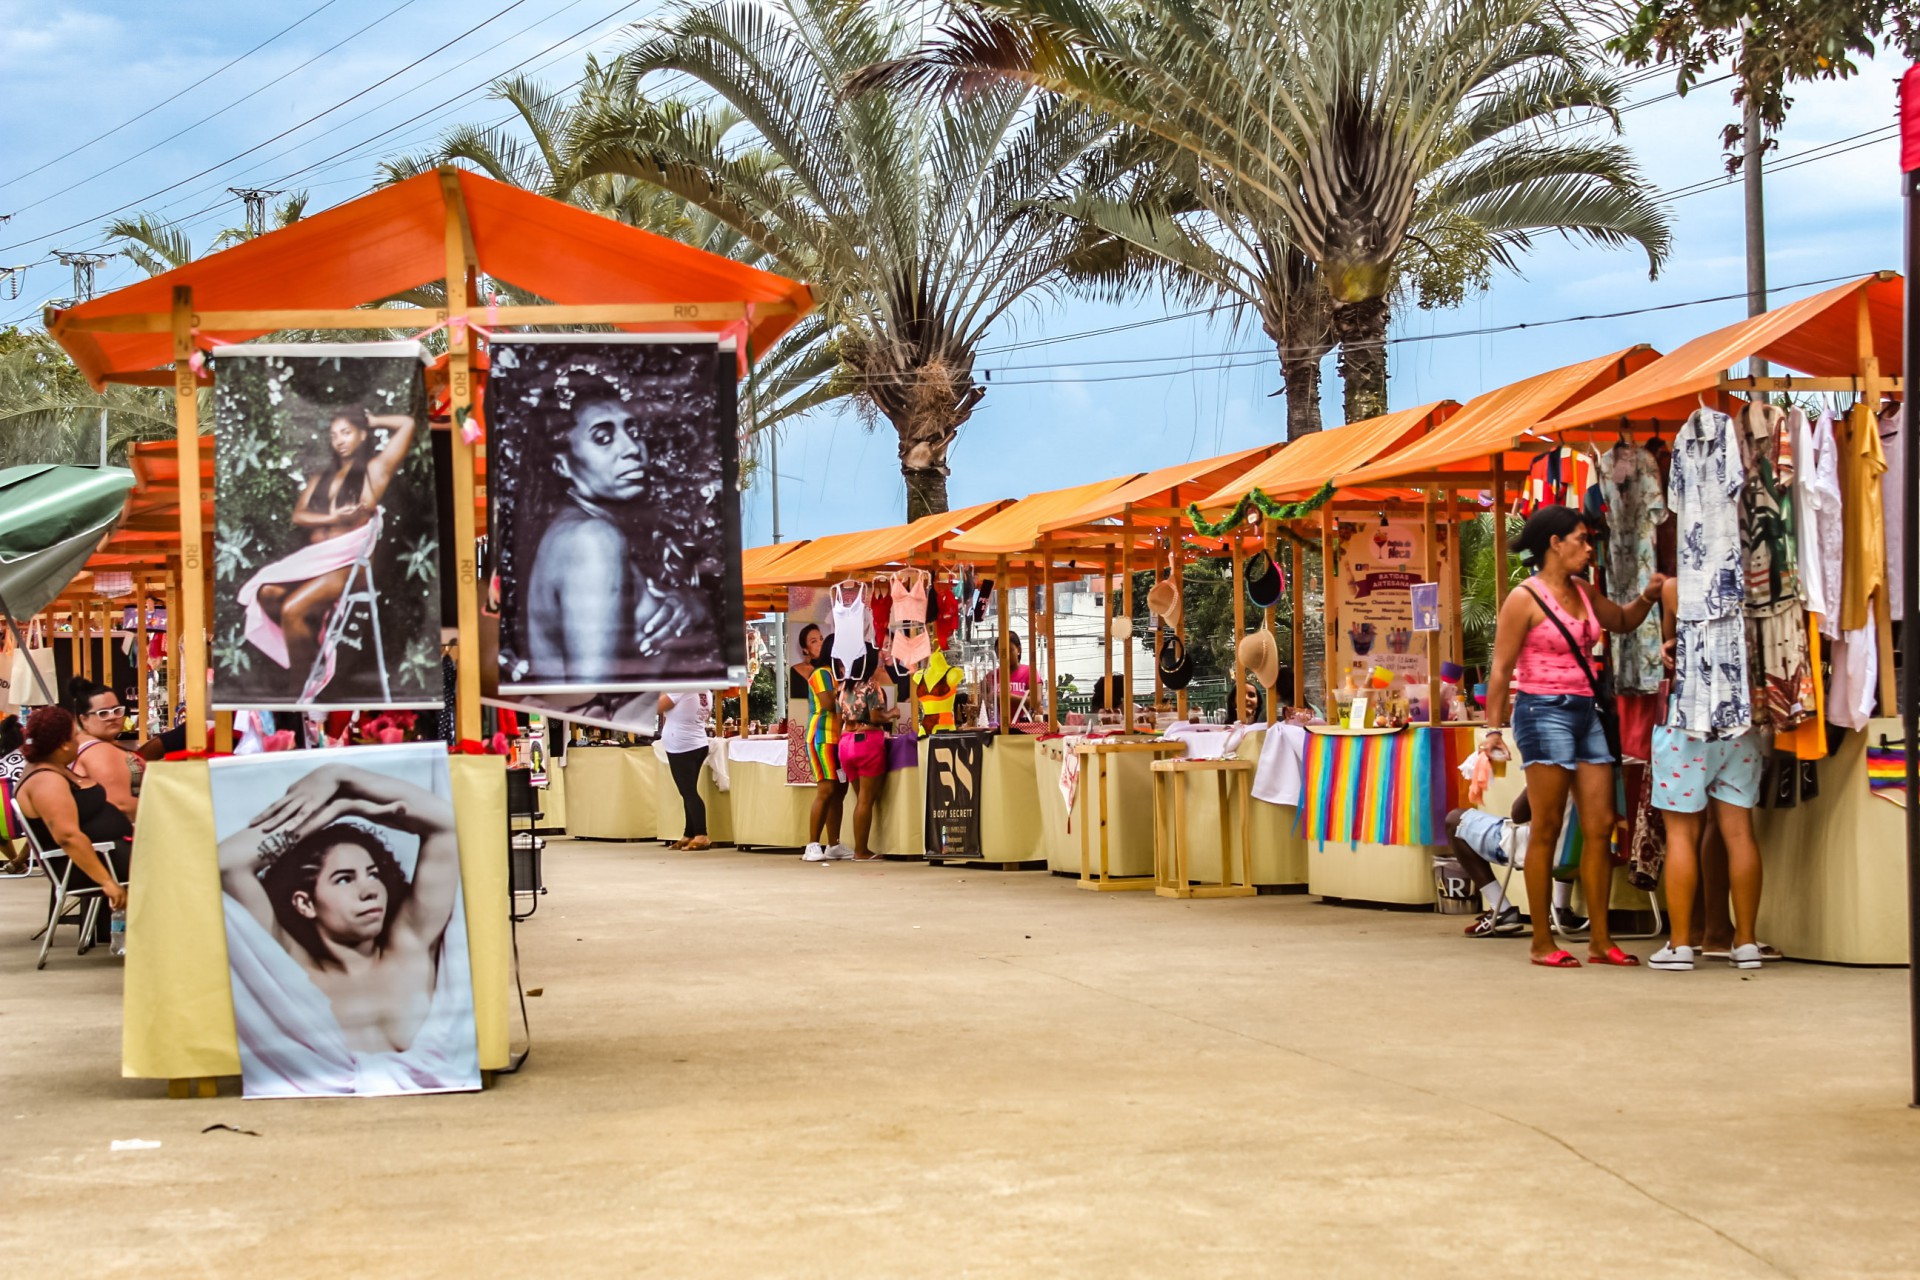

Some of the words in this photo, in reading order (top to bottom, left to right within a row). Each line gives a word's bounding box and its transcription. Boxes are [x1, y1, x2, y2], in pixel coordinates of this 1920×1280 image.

[674, 305, 699, 318] RIO
[179, 373, 193, 397] RIO
[454, 371, 467, 397] RIO
[185, 543, 199, 570] RIO
[461, 559, 473, 585] RIO
[933, 809, 948, 818] BODY
